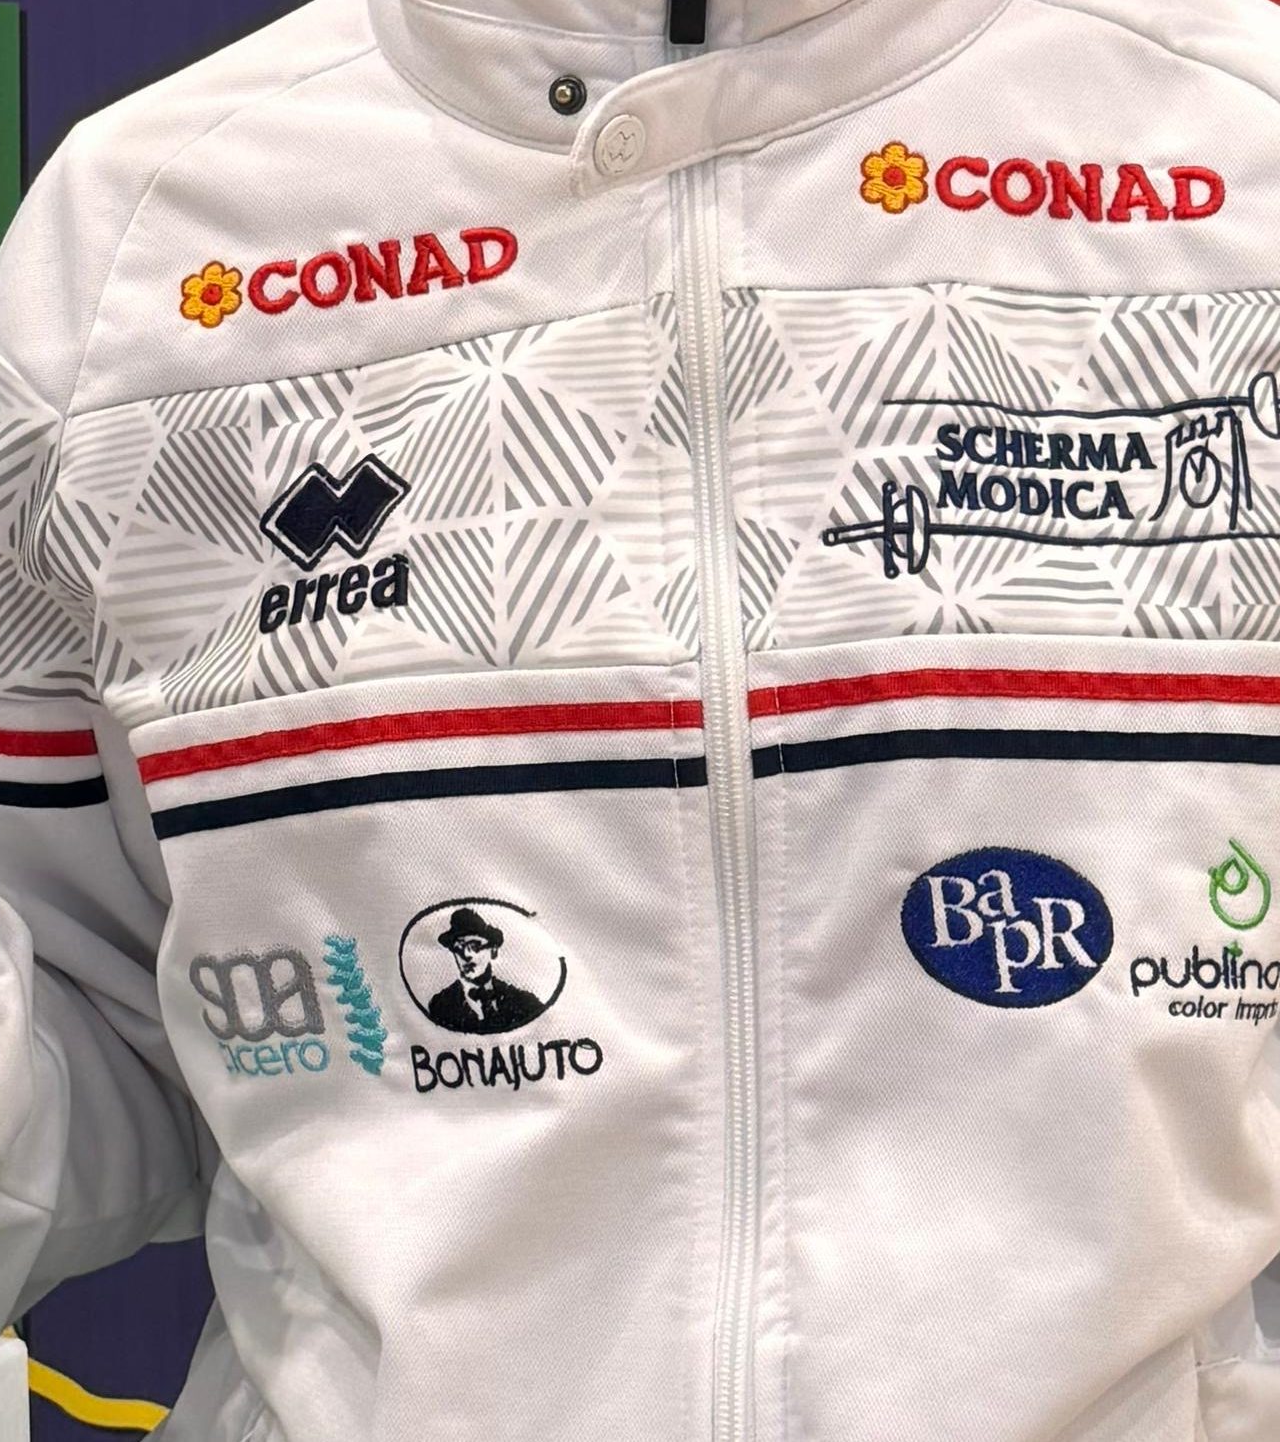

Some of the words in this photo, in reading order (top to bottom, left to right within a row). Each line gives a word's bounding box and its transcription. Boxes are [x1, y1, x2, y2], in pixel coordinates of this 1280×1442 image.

[934, 155, 1227, 223] CONAD
[247, 225, 520, 315] CONAD
[935, 423, 1158, 473] SCHERMA
[935, 469, 1135, 521] MODICA
[1168, 995, 1229, 1019] color
[410, 1038, 604, 1094] BONAJUTO
